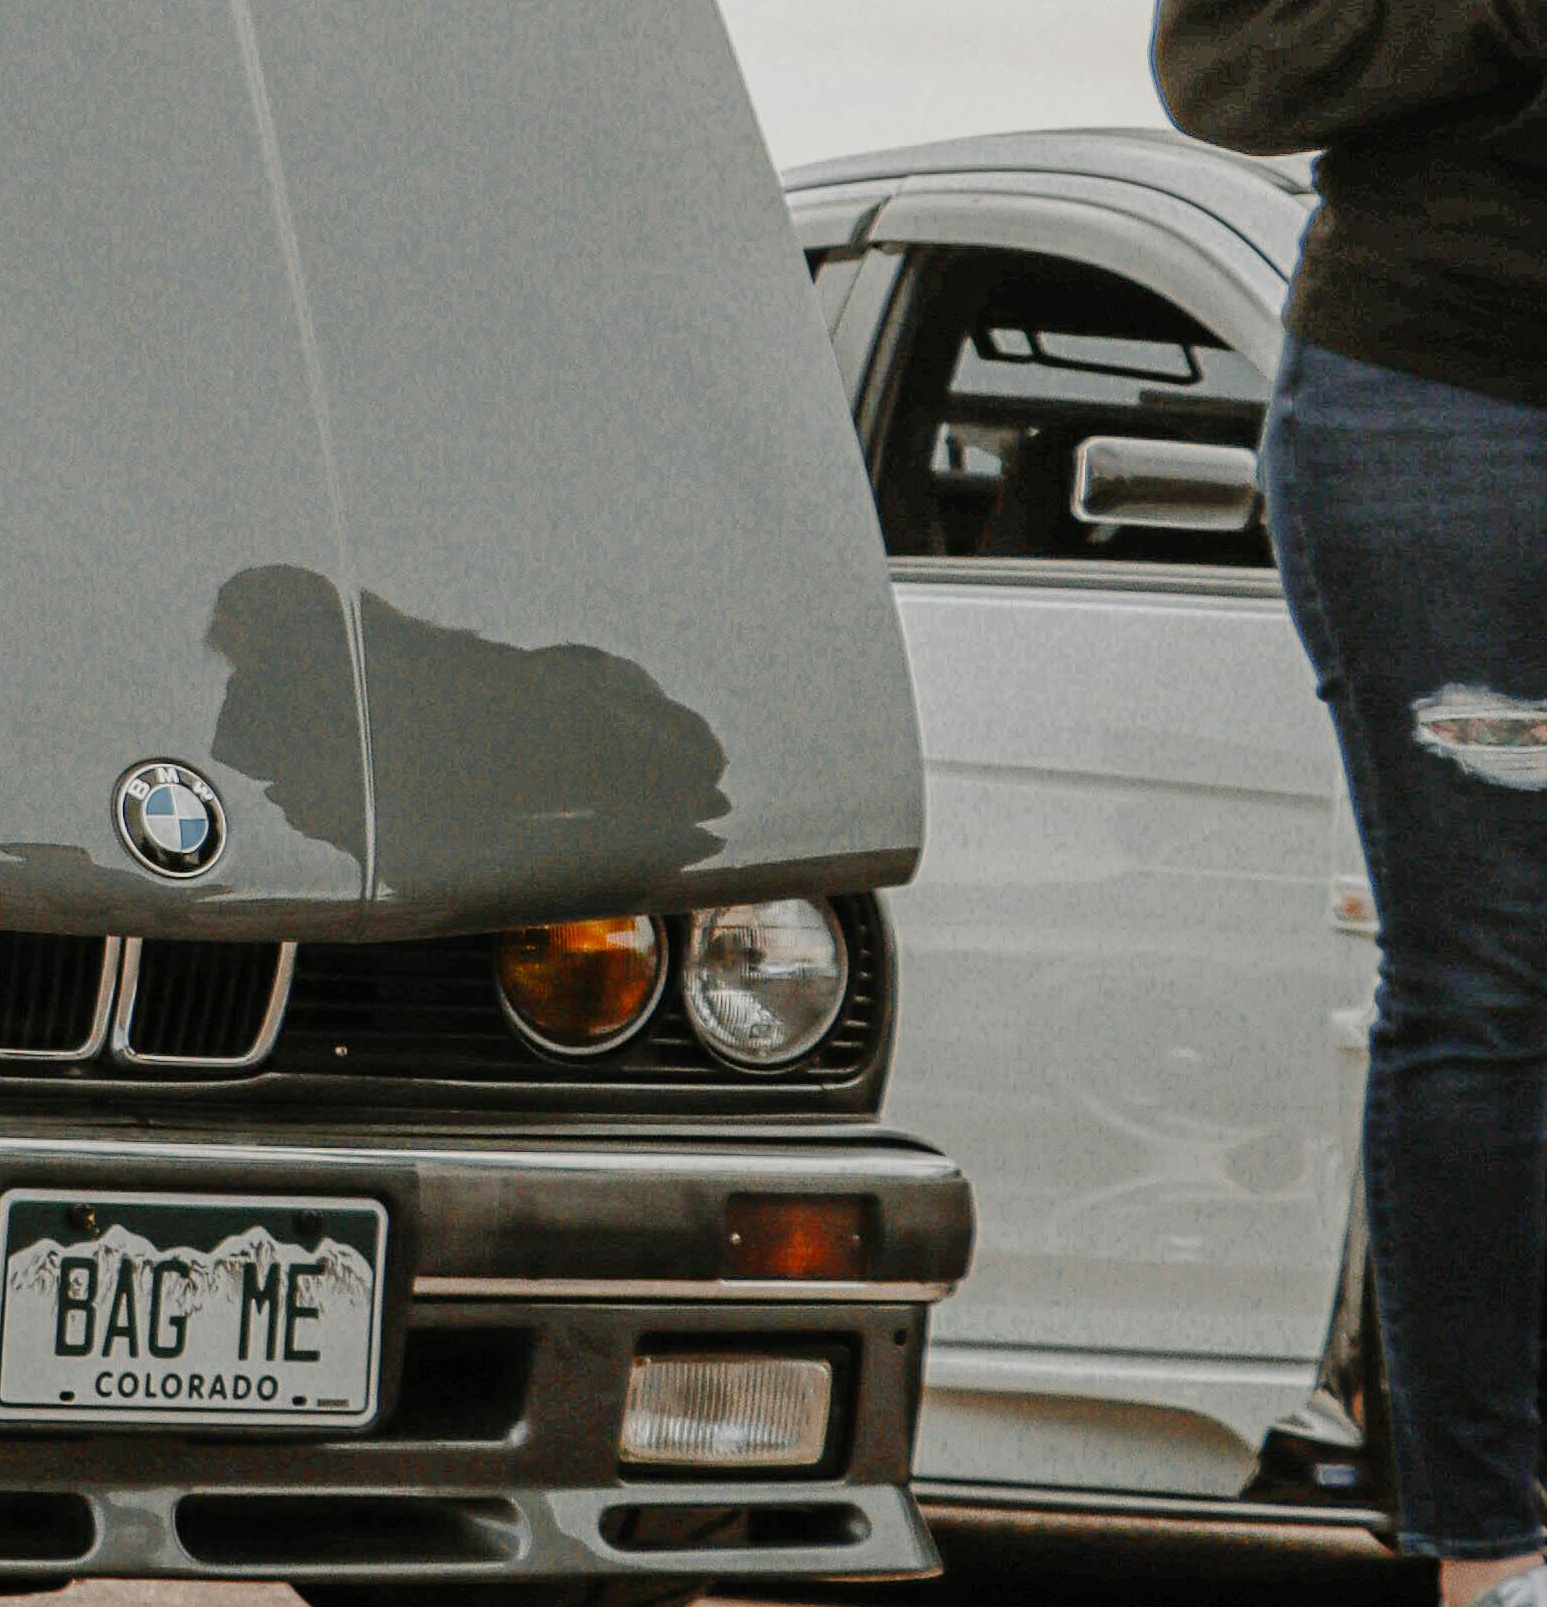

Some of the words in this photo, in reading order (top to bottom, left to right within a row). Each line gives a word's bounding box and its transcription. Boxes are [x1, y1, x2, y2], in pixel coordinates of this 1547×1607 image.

[127, 767, 213, 801] BMW
[54, 1257, 190, 1359] BAG
[237, 1261, 326, 1362] ME
[94, 1370, 280, 1401] COLORADO
